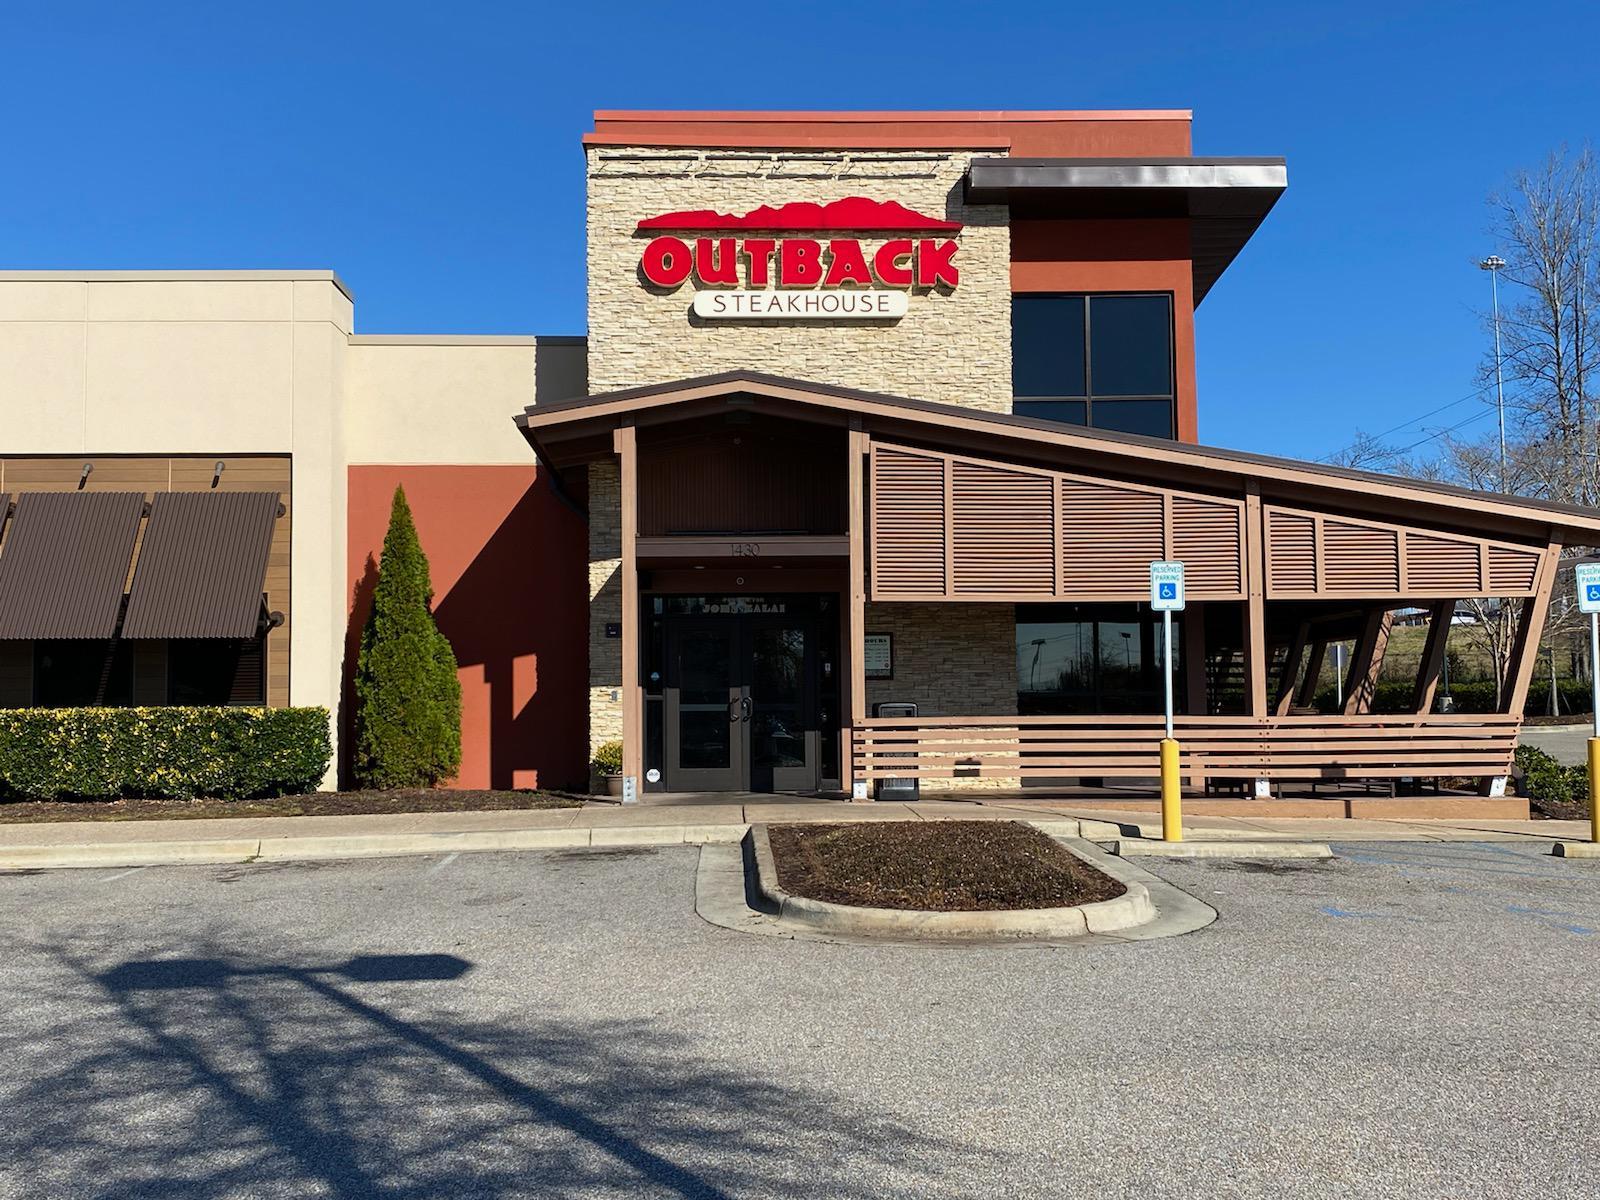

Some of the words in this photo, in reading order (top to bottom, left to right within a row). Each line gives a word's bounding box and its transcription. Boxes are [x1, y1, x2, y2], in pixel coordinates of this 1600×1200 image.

[642, 236, 959, 288] OUTBACK
[713, 294, 890, 313] STEAKHOUSE
[730, 543, 760, 557] 1430
